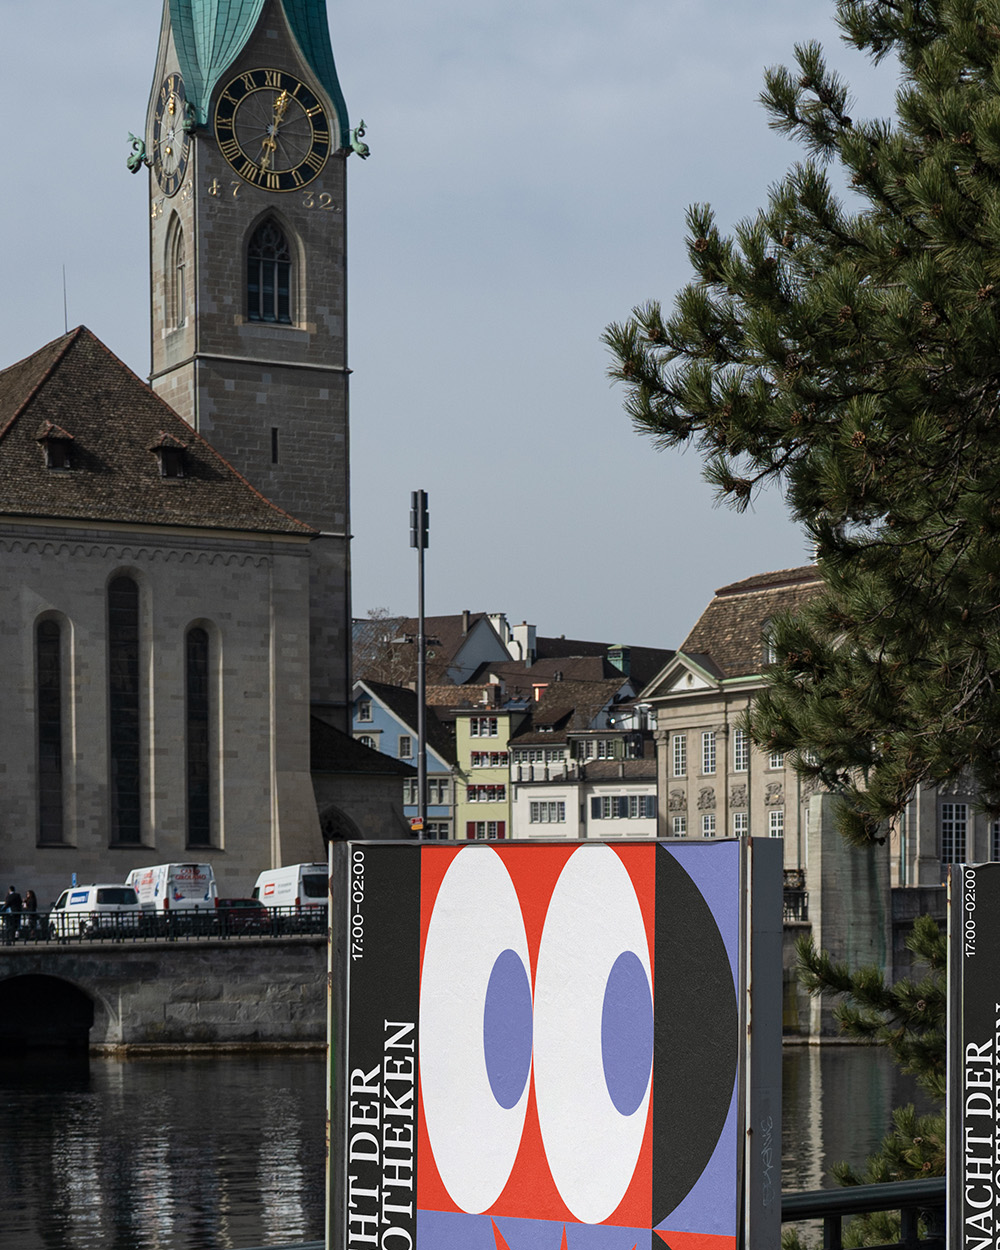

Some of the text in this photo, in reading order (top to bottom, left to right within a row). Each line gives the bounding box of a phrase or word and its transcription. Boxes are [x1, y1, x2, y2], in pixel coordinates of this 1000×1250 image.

[240, 73, 257, 92] XI
[264, 70, 282, 88] XII
[222, 90, 239, 106] X
[965, 1038, 993, 1119] DER
[349, 1063, 381, 1166] DER
